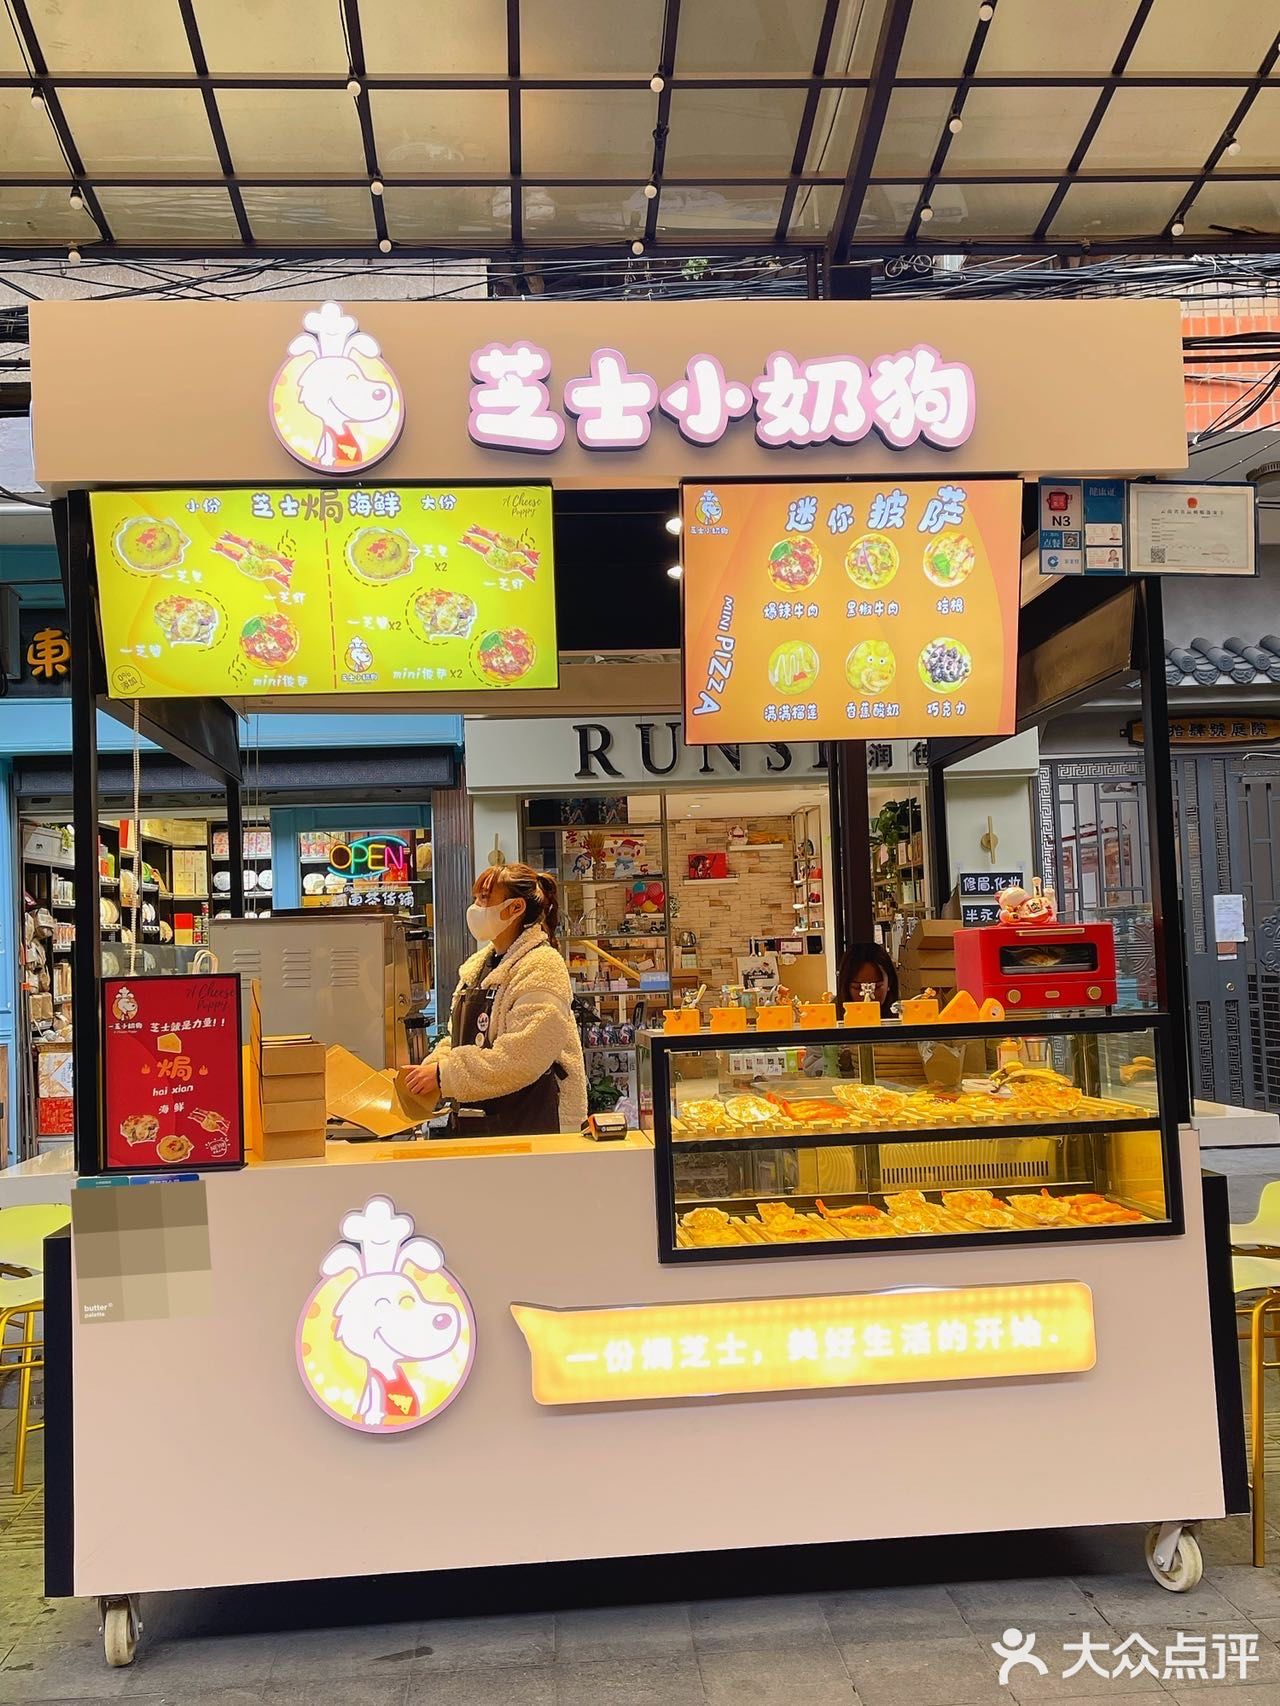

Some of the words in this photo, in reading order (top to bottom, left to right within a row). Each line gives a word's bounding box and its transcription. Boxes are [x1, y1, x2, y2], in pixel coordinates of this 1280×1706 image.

[468, 340, 976, 452] 芝士小奶狗
[185, 497, 221, 514] 小份
[251, 490, 401, 524] 芝士焗海鲜
[420, 494, 457, 511] 大份
[784, 485, 967, 534] 迷你披萨
[1051, 515, 1071, 527] N3
[717, 595, 735, 632] MINI
[763, 601, 820, 620] 爆辣牛肉
[846, 600, 900, 618] 黑椒牛肉
[936, 597, 965, 613] 培根
[27, 628, 72, 678] 東
[764, 704, 819, 722] 满满榴莲
[846, 702, 901, 719] 香蕉酸奶
[926, 701, 967, 717] 巧克力
[329, 842, 404, 874] OPEN
[965, 908, 1000, 923] 半永
[157, 1055, 193, 1081] 焗
[152, 1086, 168, 1097] hai
[171, 1084, 194, 1095] xian
[158, 1102, 185, 1115] 海鲜
